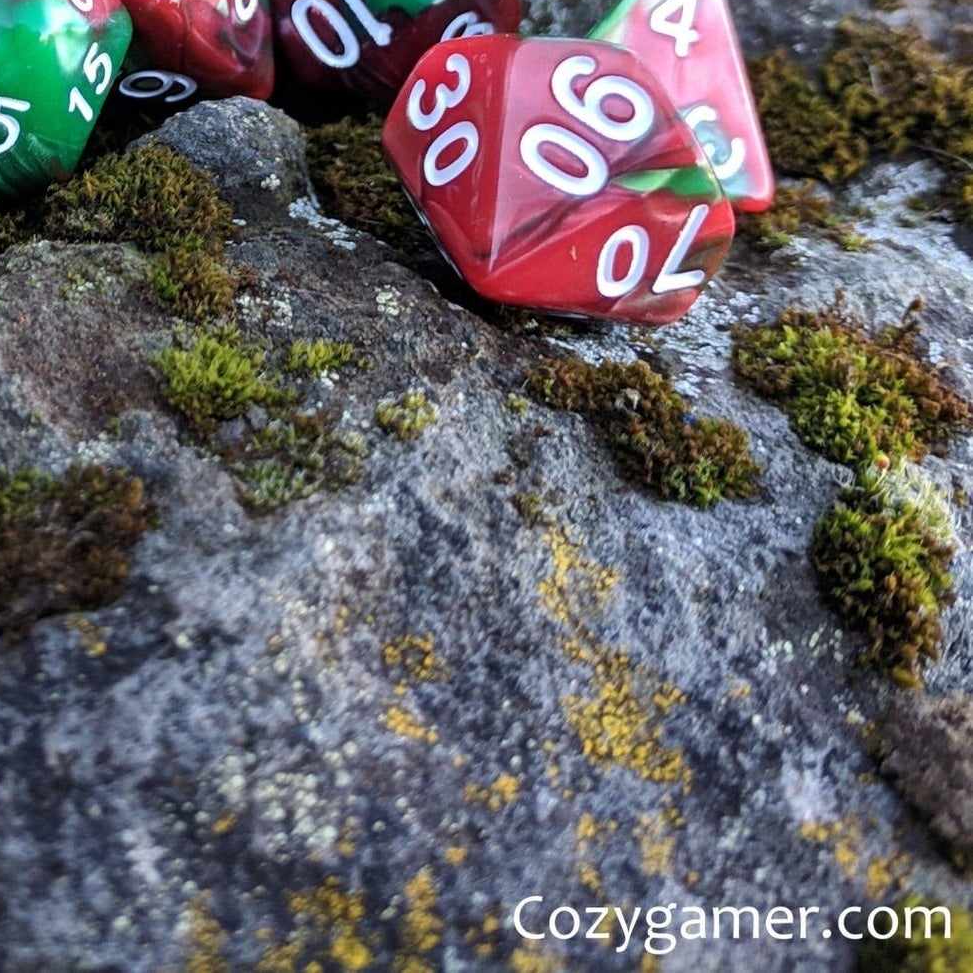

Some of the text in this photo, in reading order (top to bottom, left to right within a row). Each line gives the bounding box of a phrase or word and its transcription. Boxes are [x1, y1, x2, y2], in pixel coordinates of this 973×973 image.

[69, 42, 113, 122] 15
[407, 53, 480, 188] 30
[596, 204, 709, 298] 70
